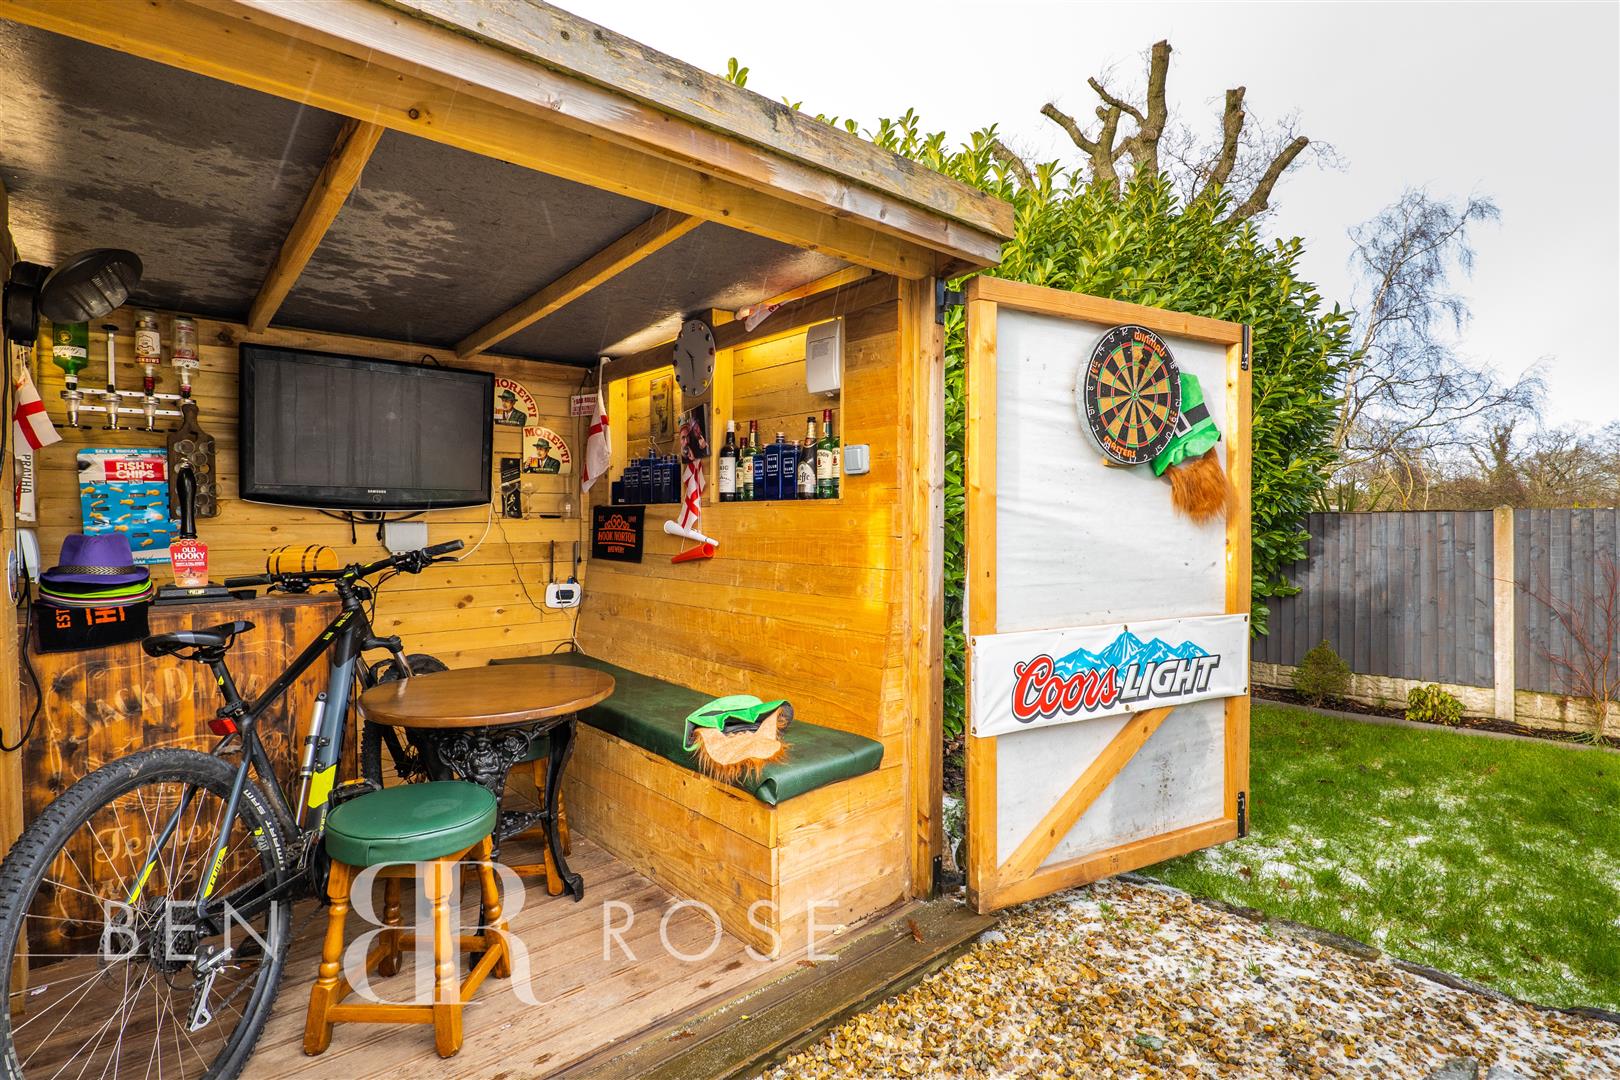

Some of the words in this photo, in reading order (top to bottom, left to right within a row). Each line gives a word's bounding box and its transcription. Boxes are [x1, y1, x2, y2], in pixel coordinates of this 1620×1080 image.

[523, 427, 571, 464] MORETTI
[116, 462, 144, 470] FISH
[116, 470, 155, 479] CHIPS
[174, 552, 205, 560] HOOKY
[1012, 654, 1119, 722] Coors
[1120, 654, 1221, 702] LIGHT
